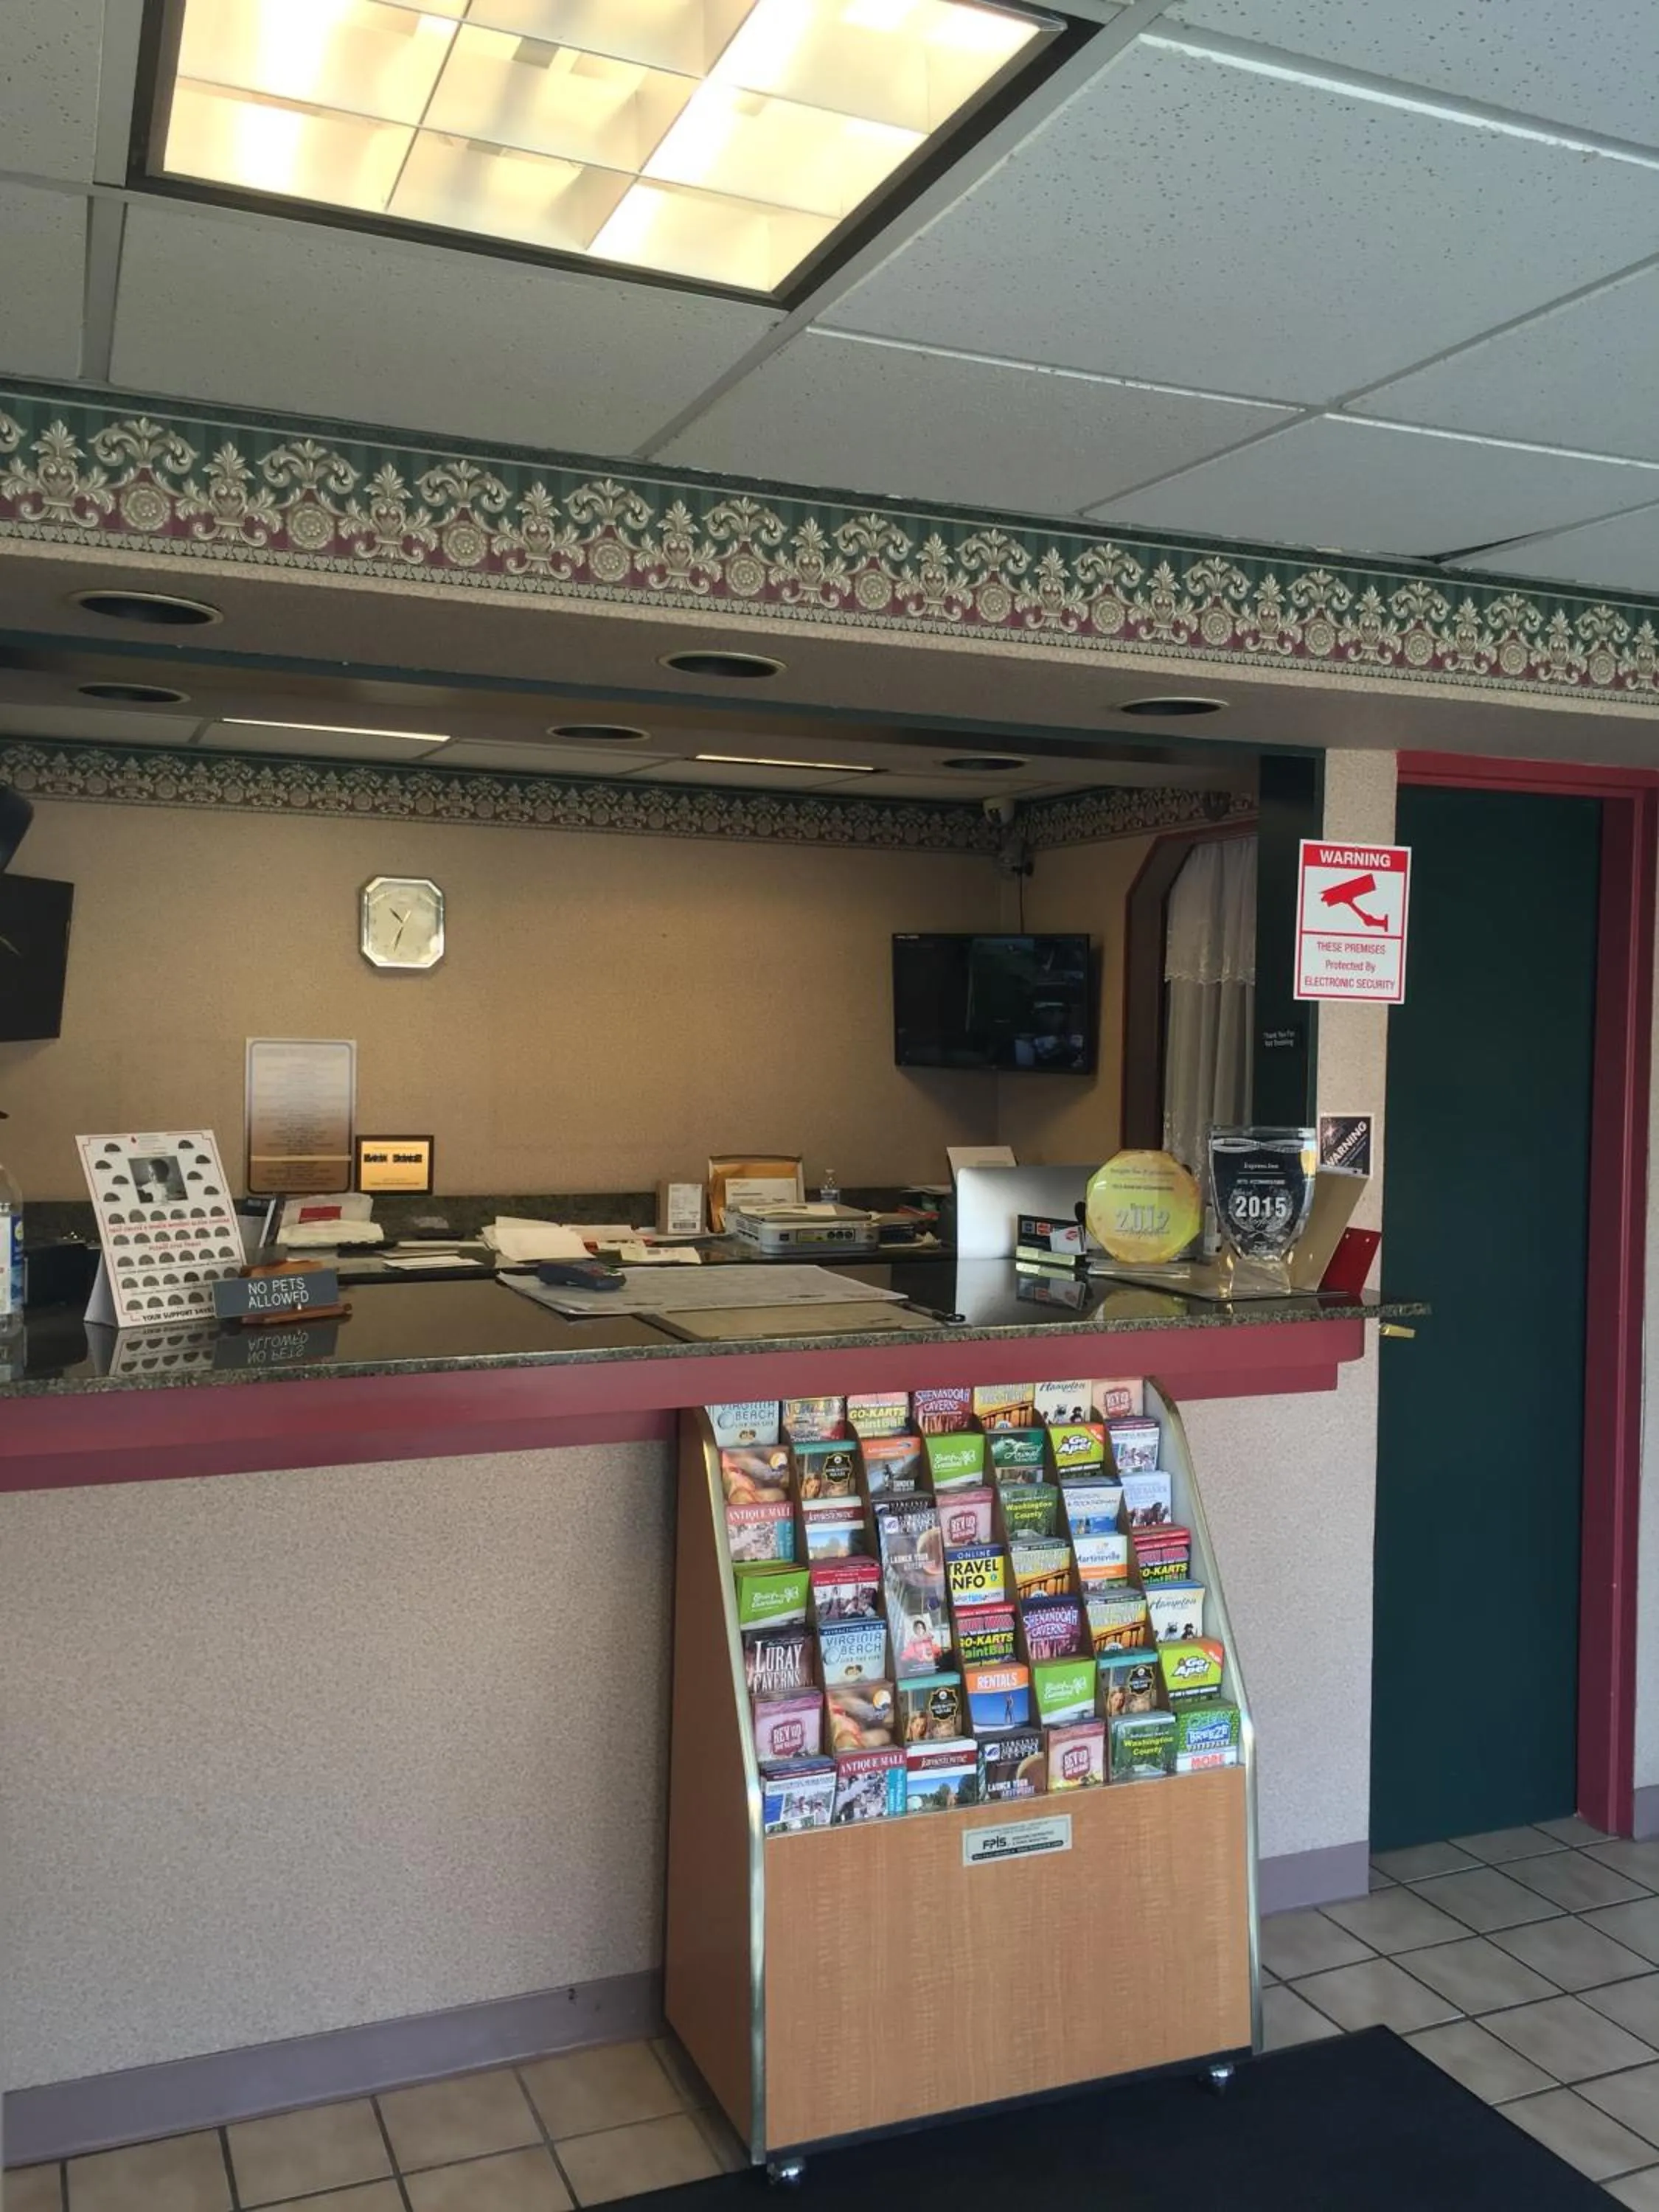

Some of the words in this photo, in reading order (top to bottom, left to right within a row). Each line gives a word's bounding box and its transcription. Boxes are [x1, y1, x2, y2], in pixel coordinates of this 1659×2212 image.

[1320, 849, 1391, 867] WARNING
[1317, 942, 1343, 953] THESE
[1344, 943, 1386, 955] PREMISES
[1326, 960, 1363, 971] Protected
[1366, 961, 1376, 973] By
[1304, 975, 1354, 988] ELECTRONIC
[1356, 978, 1396, 990] SECURITY
[1235, 1195, 1287, 1217] 2015
[248, 1281, 267, 1295] NO
[272, 1277, 305, 1292] PETS
[248, 1290, 310, 1309] ALLOWED
[915, 1388, 972, 1405] SHENANDOAH
[849, 1407, 906, 1419] GO-KARTS
[924, 1401, 959, 1412] CAVERNS
[735, 1409, 775, 1421] BEACH
[1069, 1436, 1088, 1445] Go
[1006, 1501, 1053, 1511] Washington
[729, 1510, 767, 1521] ANTIQUE
[769, 1507, 791, 1517] MALL
[1015, 1511, 1043, 1520] County
[957, 1549, 991, 1559] ONLINE
[947, 1559, 998, 1576] TRAVEL
[1140, 1562, 1189, 1577] O-KARTS
[952, 1574, 986, 1590] NFO
[1023, 1610, 1079, 1629] SHENANDOAH
[1031, 1623, 1067, 1637] CAVERNS
[826, 1632, 883, 1646] VIRGINIA
[841, 1643, 882, 1656] BEACH
[755, 1641, 803, 1673] LURAY
[1185, 1657, 1206, 1666] Go
[1175, 1662, 1211, 1677] Ape!
[753, 1669, 801, 1694] CAVERNS
[978, 1672, 1018, 1688] RENTALS
[1123, 1736, 1174, 1747] Washington
[1133, 1747, 1163, 1756] County
[840, 1758, 878, 1773] ANTIQUE
[880, 1754, 905, 1767] MALL
